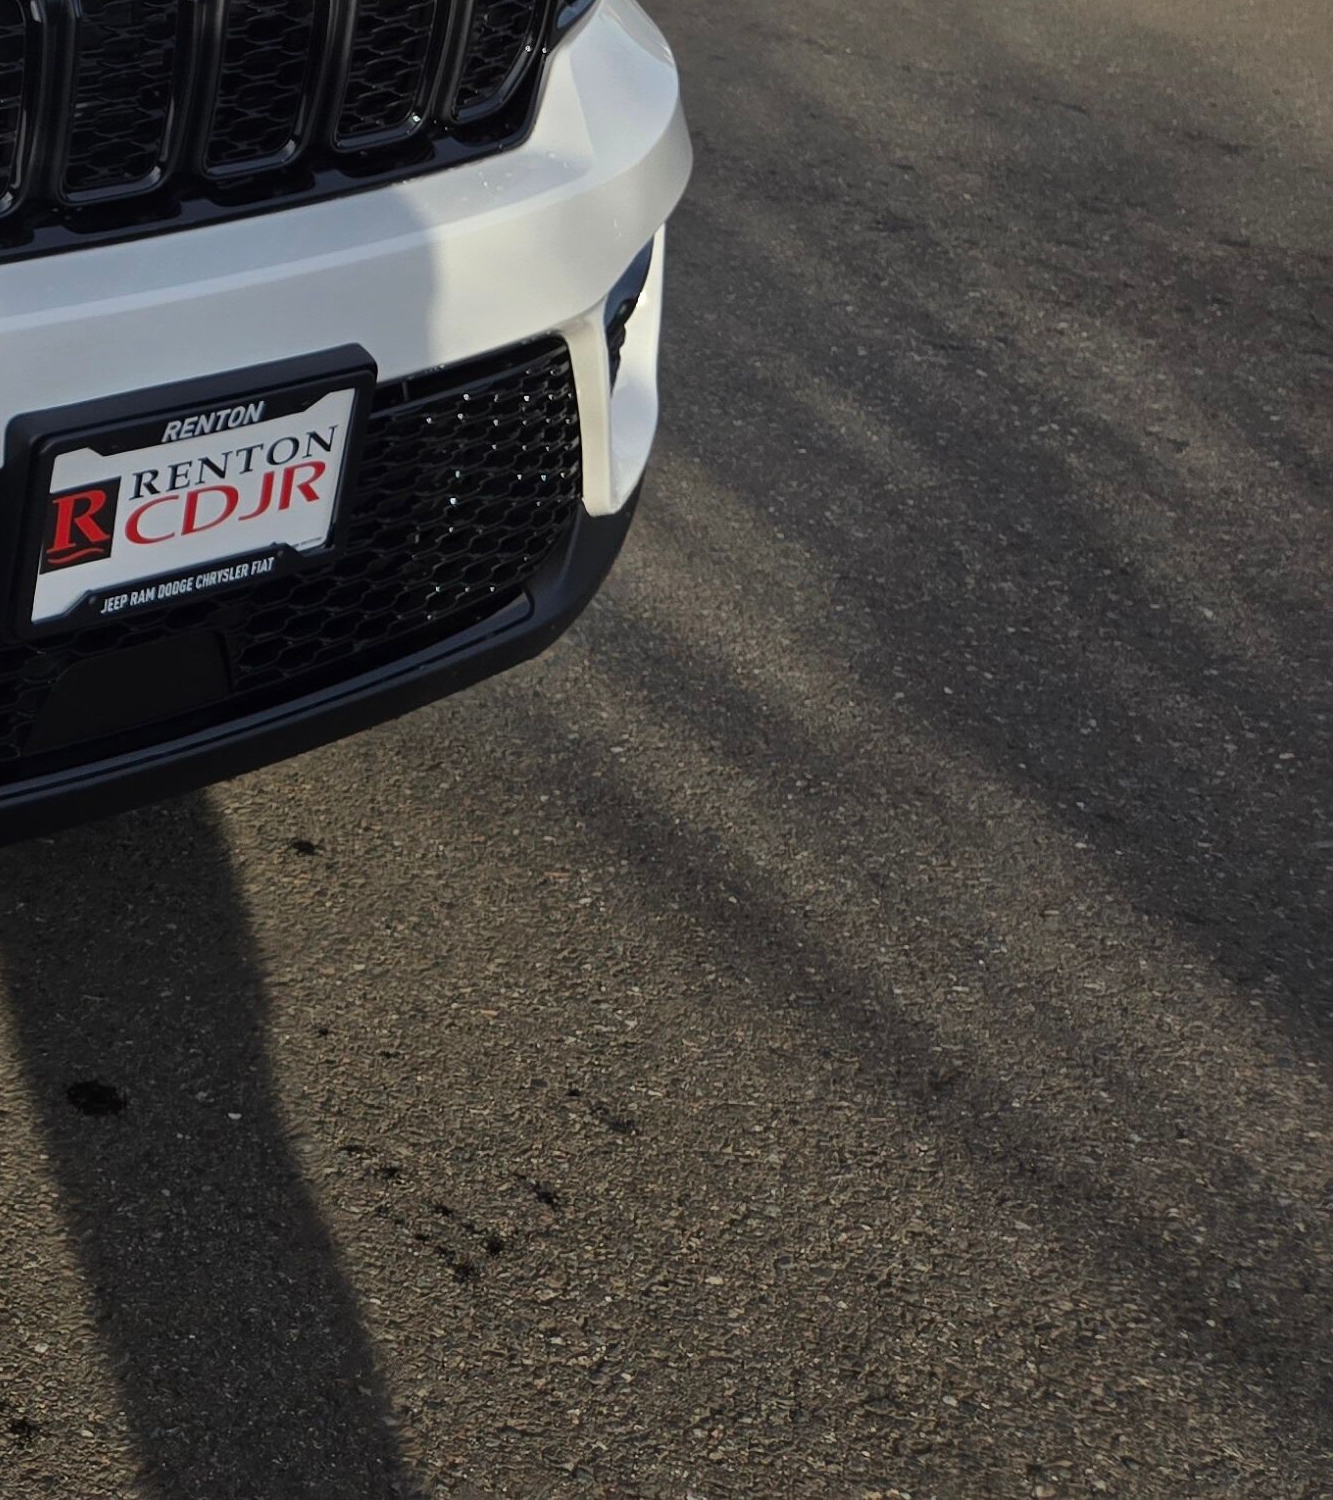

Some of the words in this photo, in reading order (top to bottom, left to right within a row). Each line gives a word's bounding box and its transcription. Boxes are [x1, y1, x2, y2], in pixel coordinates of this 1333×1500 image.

[161, 400, 265, 443] RENTON
[129, 425, 339, 501] RENTON
[46, 489, 111, 554] R
[124, 460, 327, 545] CDJR
[100, 593, 128, 614] JEEP
[130, 586, 156, 606] RAM
[157, 577, 194, 599] DODGE
[195, 563, 249, 590] CHRYSLER
[250, 557, 275, 576] FIAT
